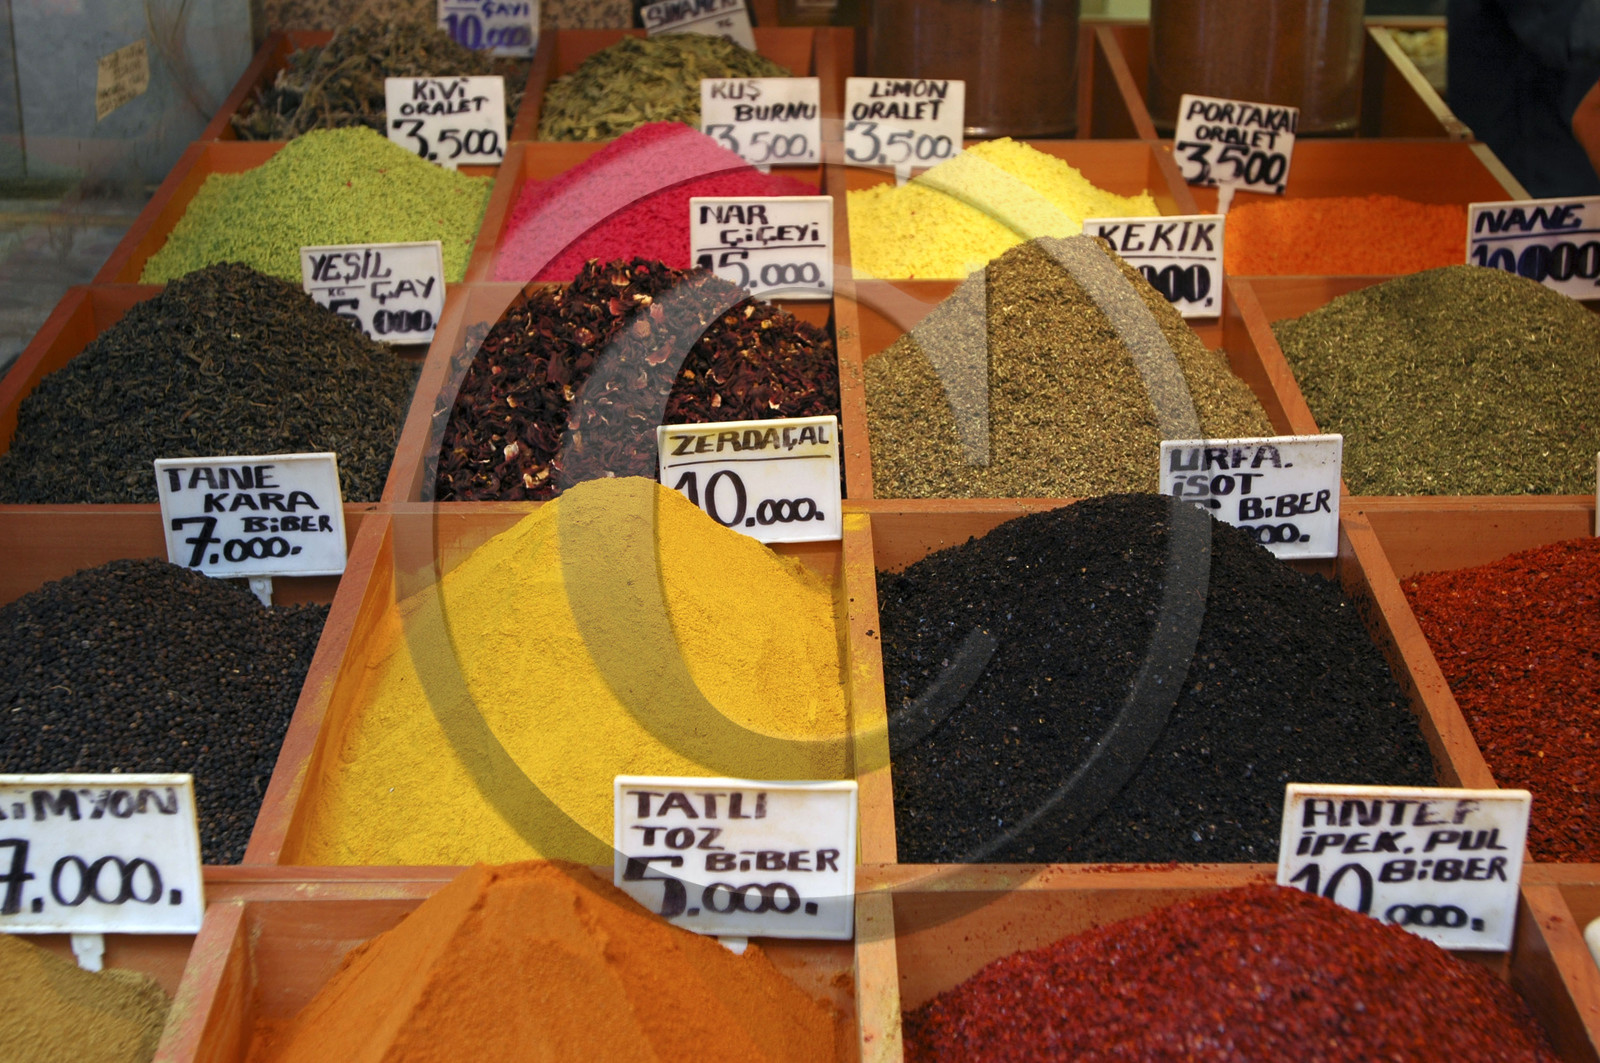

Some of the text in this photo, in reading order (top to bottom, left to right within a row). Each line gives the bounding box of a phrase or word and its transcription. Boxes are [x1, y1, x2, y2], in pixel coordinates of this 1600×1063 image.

[711, 80, 761, 101] KUŞ
[400, 96, 489, 115] ORALET
[734, 101, 817, 122] BURNU
[852, 100, 944, 121] ORALET
[1196, 125, 1279, 149] ORALET
[700, 205, 768, 225] NAR
[1475, 204, 1585, 233] NANE
[328, 288, 345, 297] KG
[371, 276, 435, 304] ÇAY
[669, 425, 829, 455] ZERDAÇAL
[163, 465, 280, 492] TANE
[204, 491, 319, 512] KARA
[171, 516, 302, 567] 7.000.
[0, 787, 178, 821] İMYON
[627, 791, 767, 819] TATLI
[631, 826, 725, 850] TOZ
[1423, 829, 1507, 852] PUL
[0, 838, 182, 915] 7.000.
[623, 856, 818, 918] 5.000.
